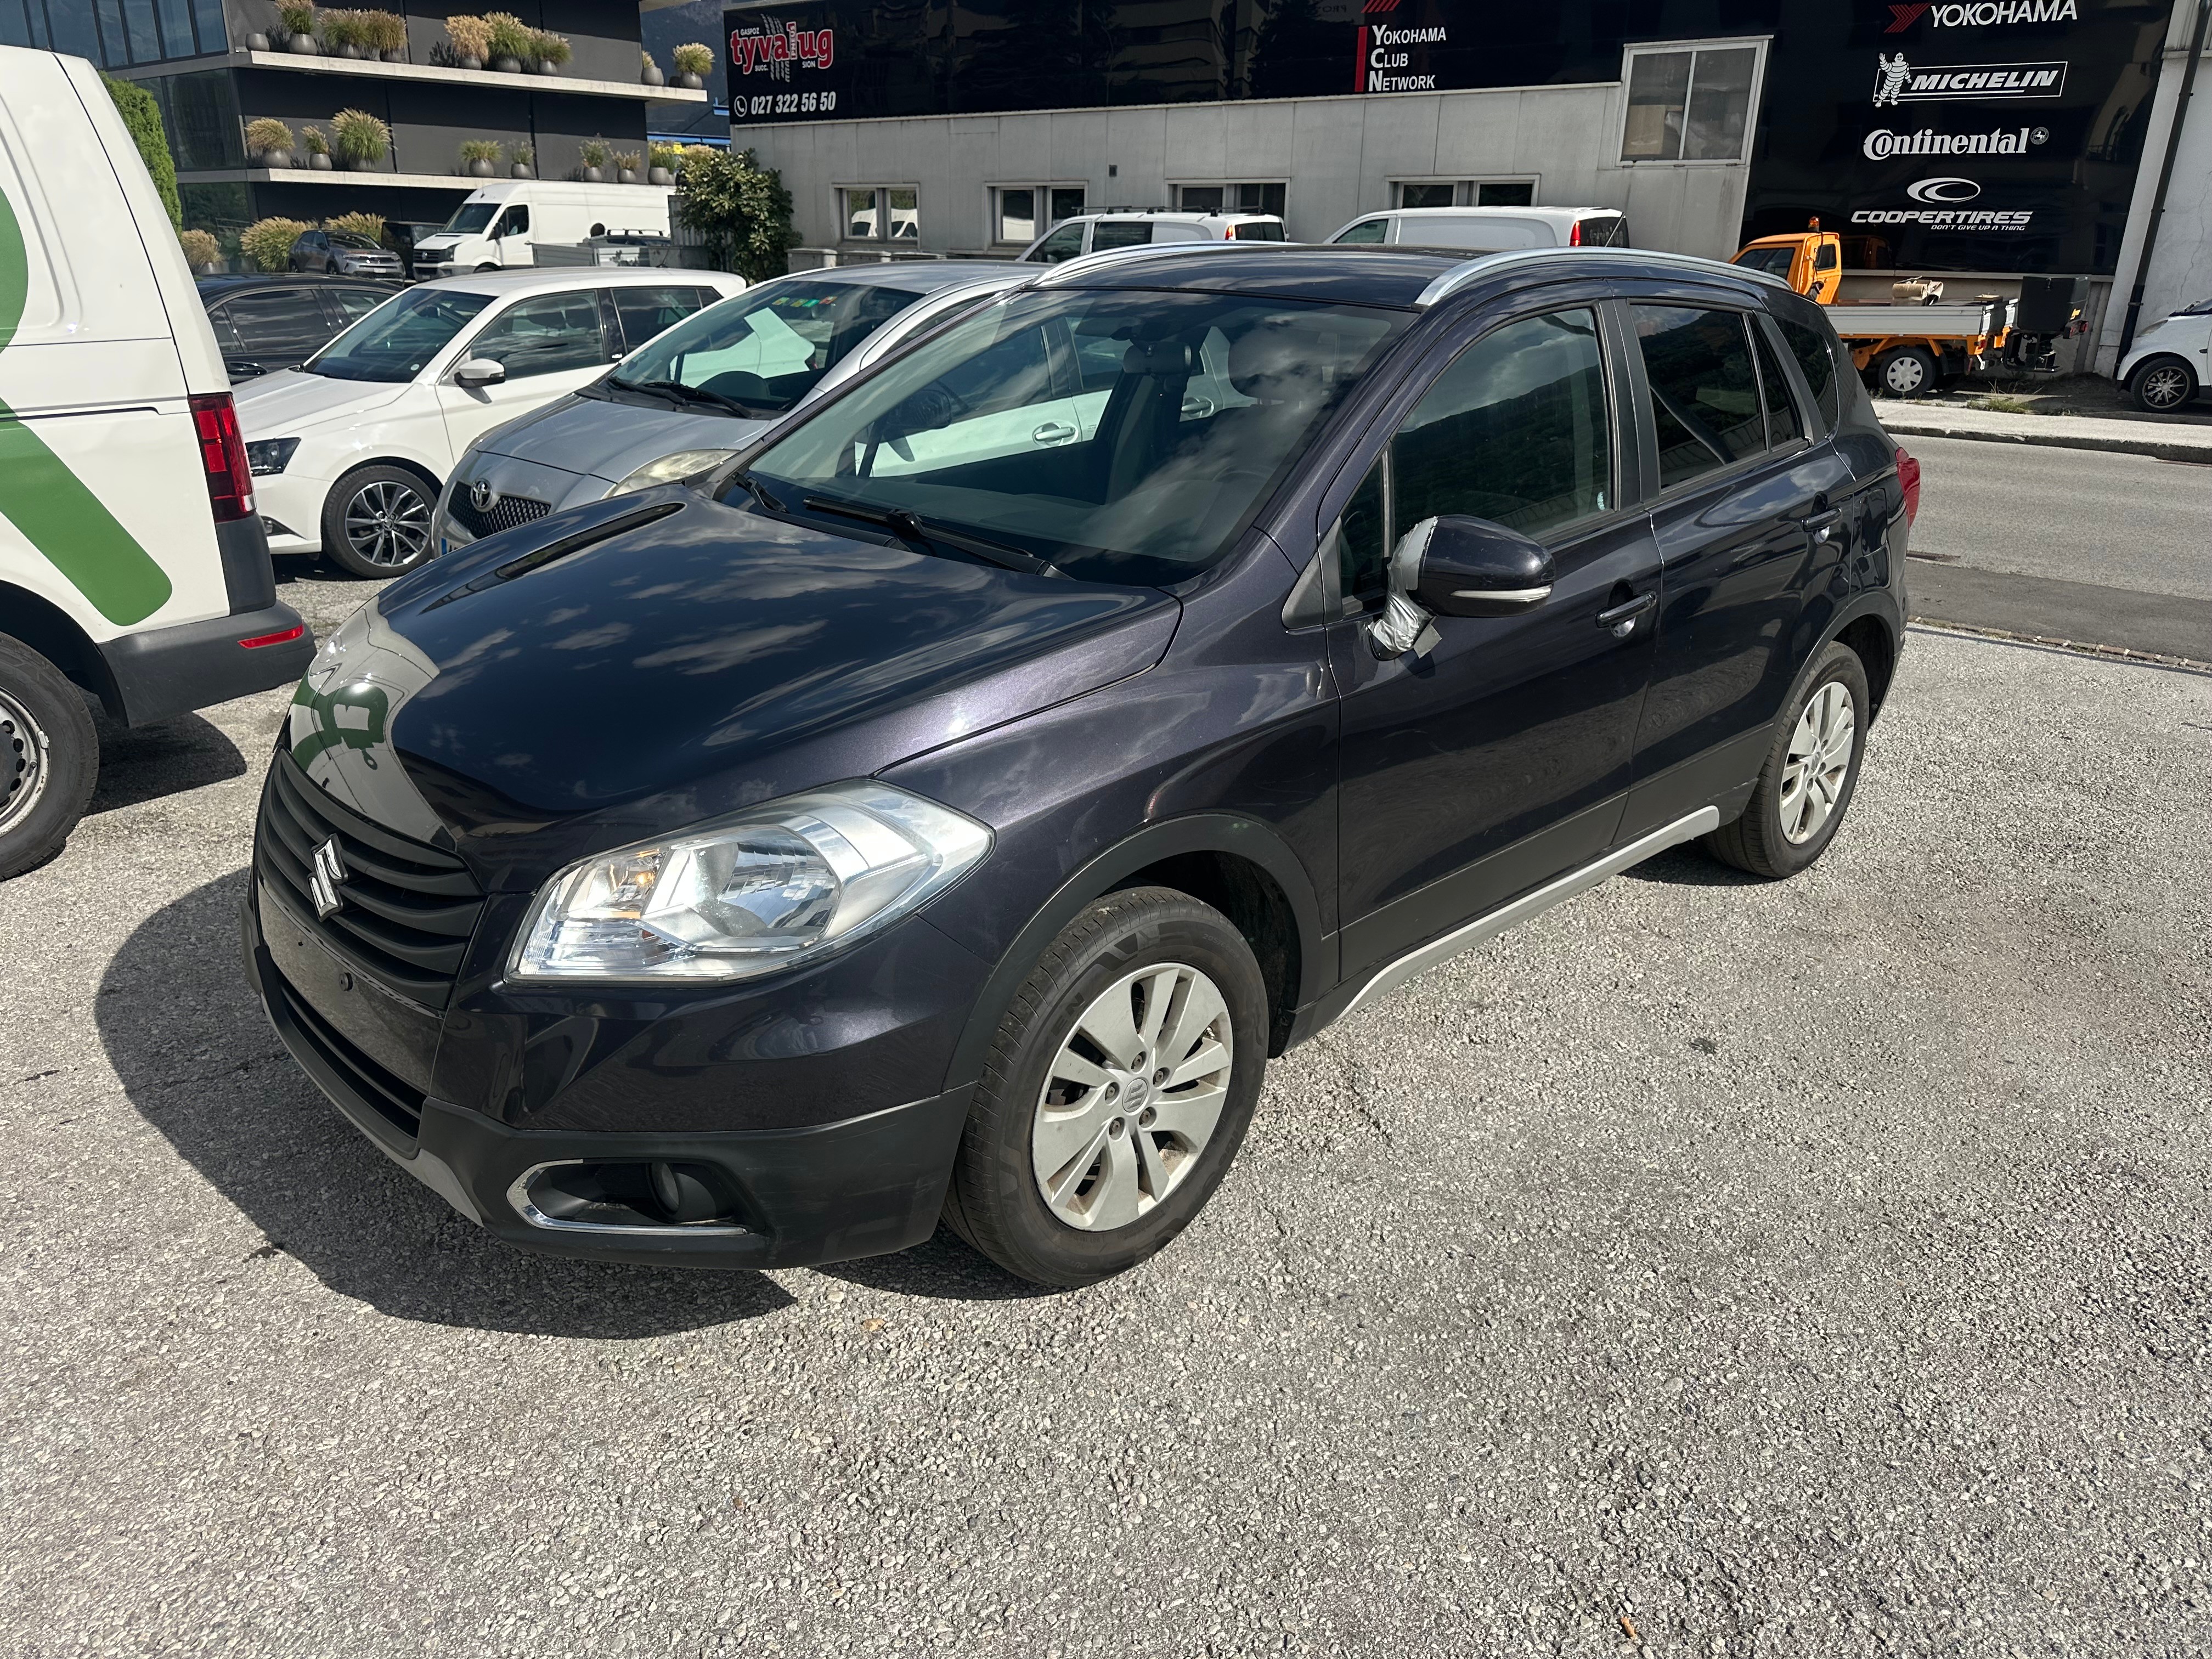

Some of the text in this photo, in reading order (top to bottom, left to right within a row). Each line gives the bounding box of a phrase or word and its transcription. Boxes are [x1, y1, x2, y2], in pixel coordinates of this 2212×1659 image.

[1931, 0, 2078, 27] YOKOHAMA
[740, 27, 760, 36] GASPOZ
[1372, 24, 1446, 45] YOKOHAMA
[730, 21, 833, 75] tyvalug
[1370, 48, 1408, 68] CLUB
[1368, 70, 1435, 92] NETWORK
[1910, 70, 2059, 90] MICHELIN
[751, 91, 836, 115] 027 322 56 50
[1863, 127, 2029, 161] Continental
[1850, 211, 2034, 224] COOPERTIRES
